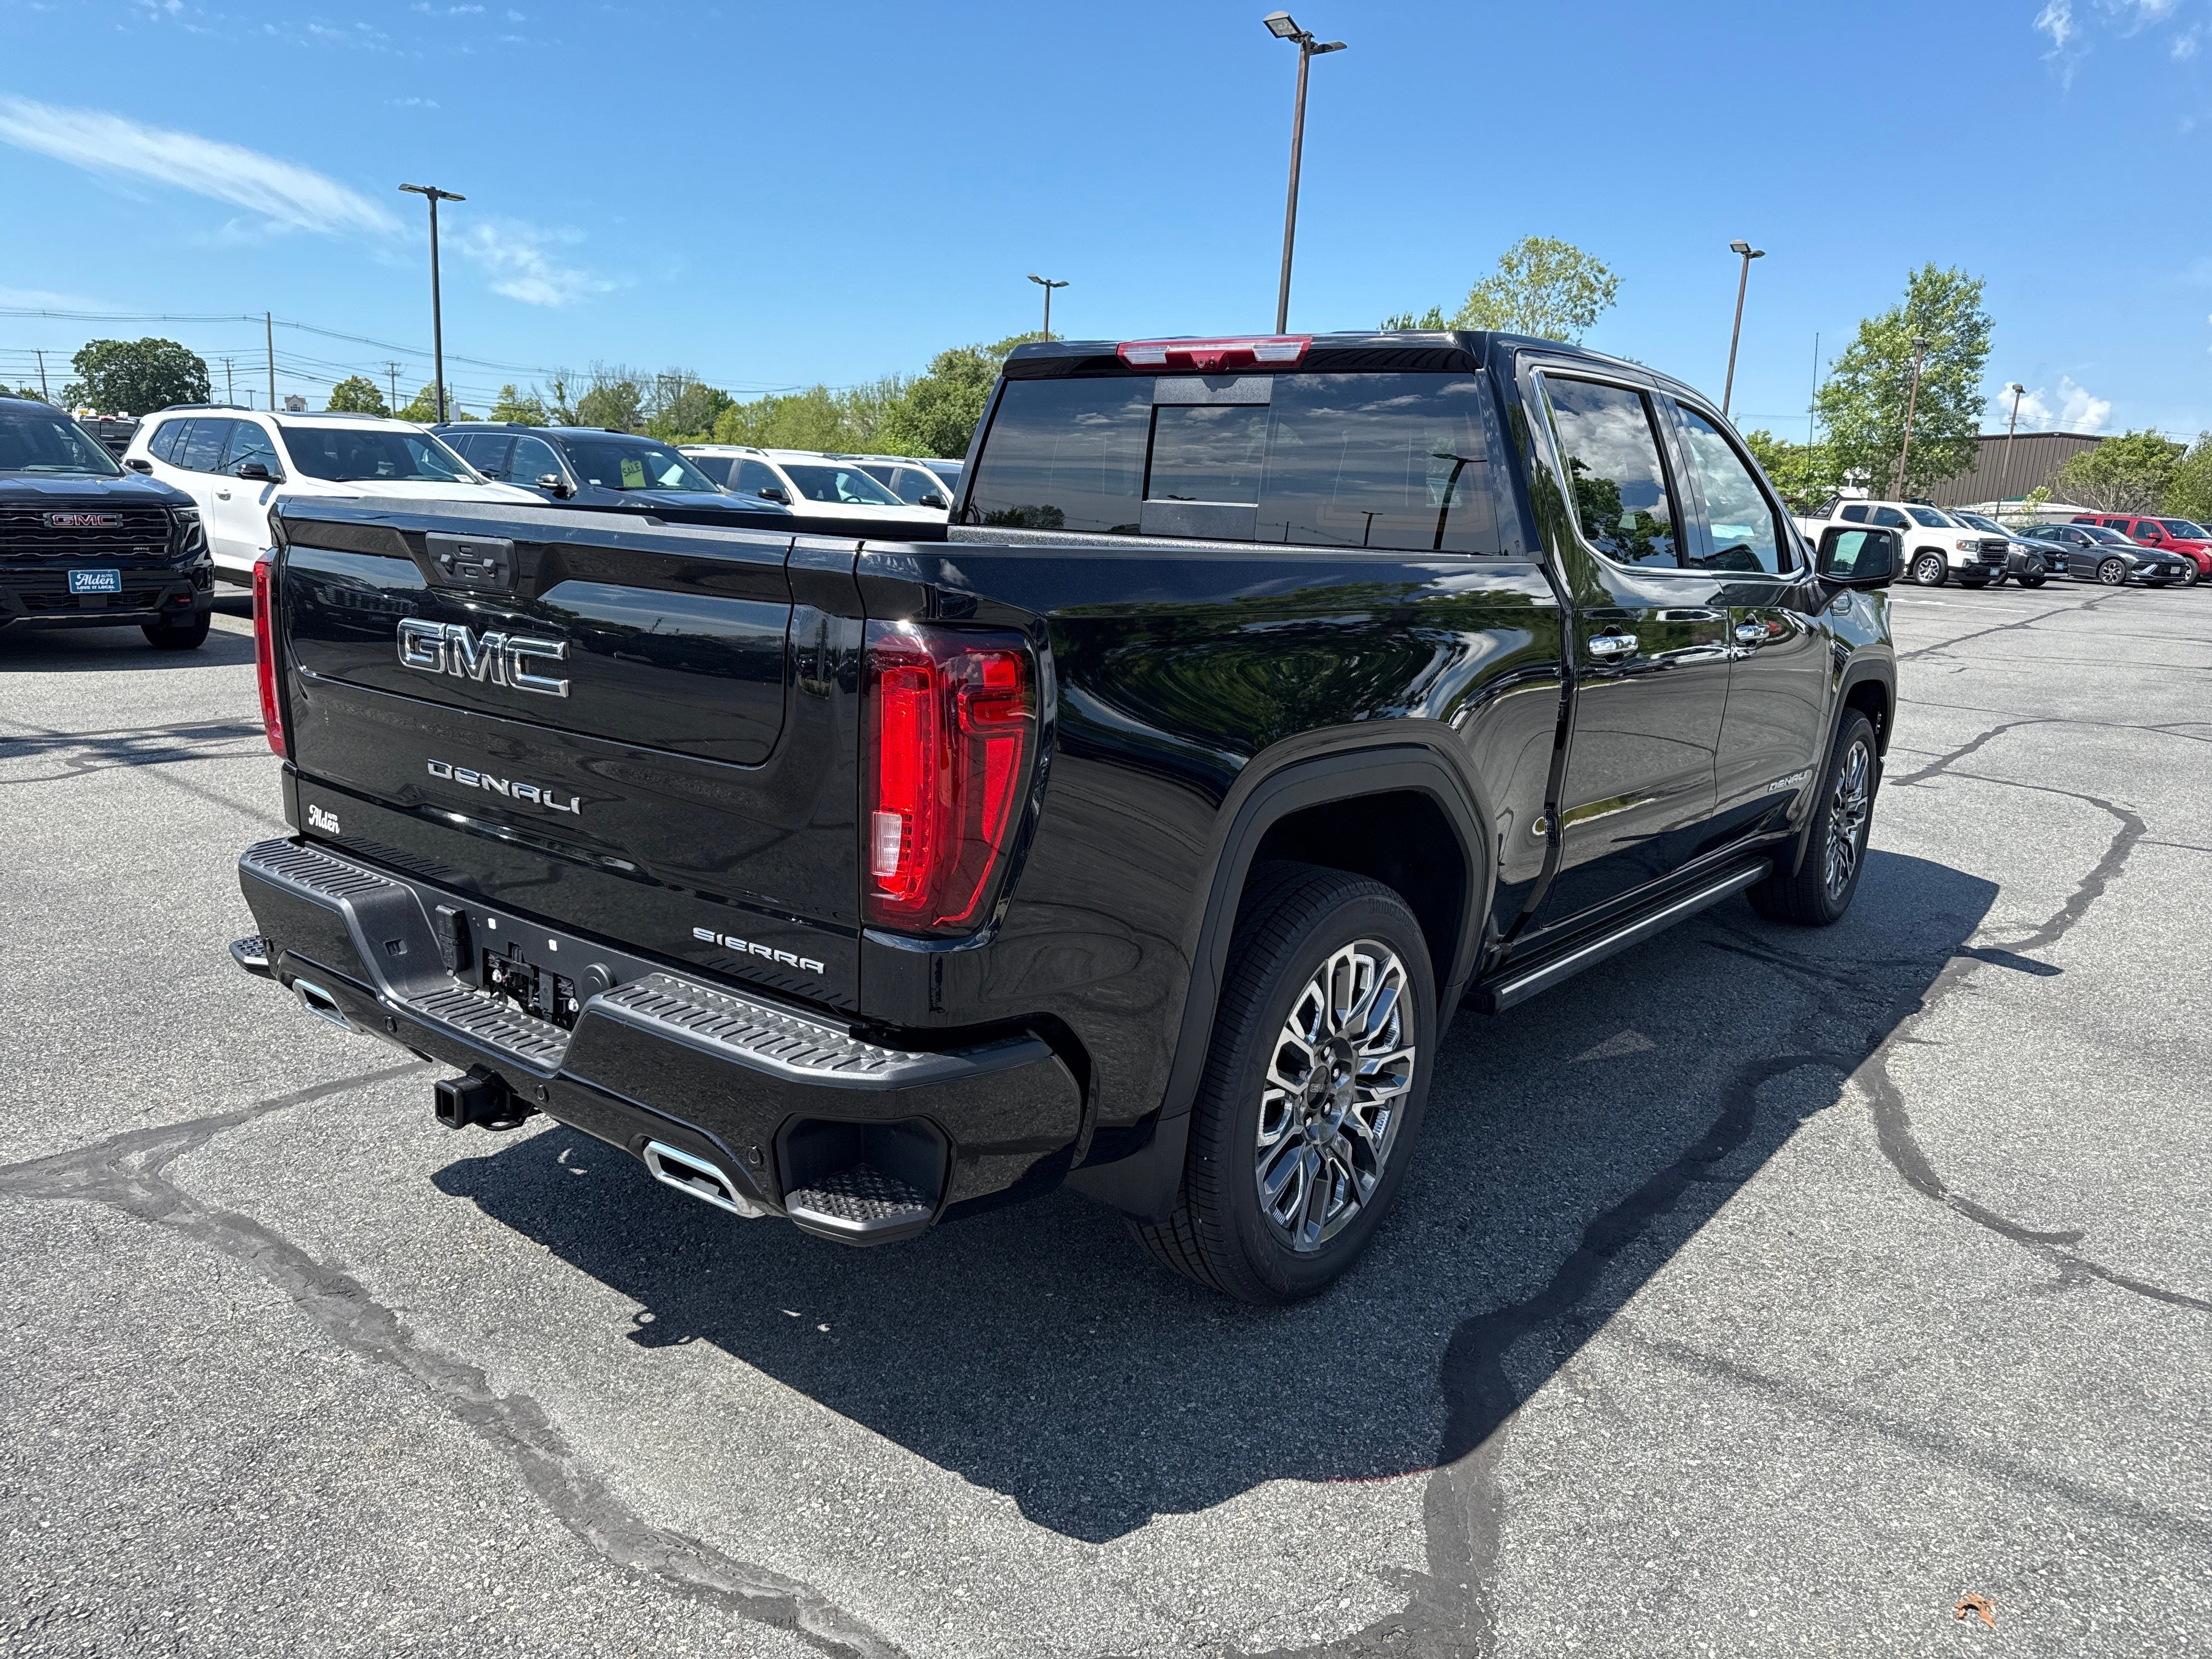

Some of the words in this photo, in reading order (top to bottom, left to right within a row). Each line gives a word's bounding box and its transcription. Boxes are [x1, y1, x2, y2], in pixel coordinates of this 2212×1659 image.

[622, 462, 642, 477] SALE
[52, 515, 117, 526] GMC
[75, 573, 115, 585] Alden
[397, 617, 571, 698] GMC
[427, 758, 582, 815] DENALI
[1769, 770, 1808, 791] DENALI
[308, 804, 340, 834] Alden
[1368, 898, 1417, 937] BRIDGESTONE
[693, 927, 825, 974] SIERRA
